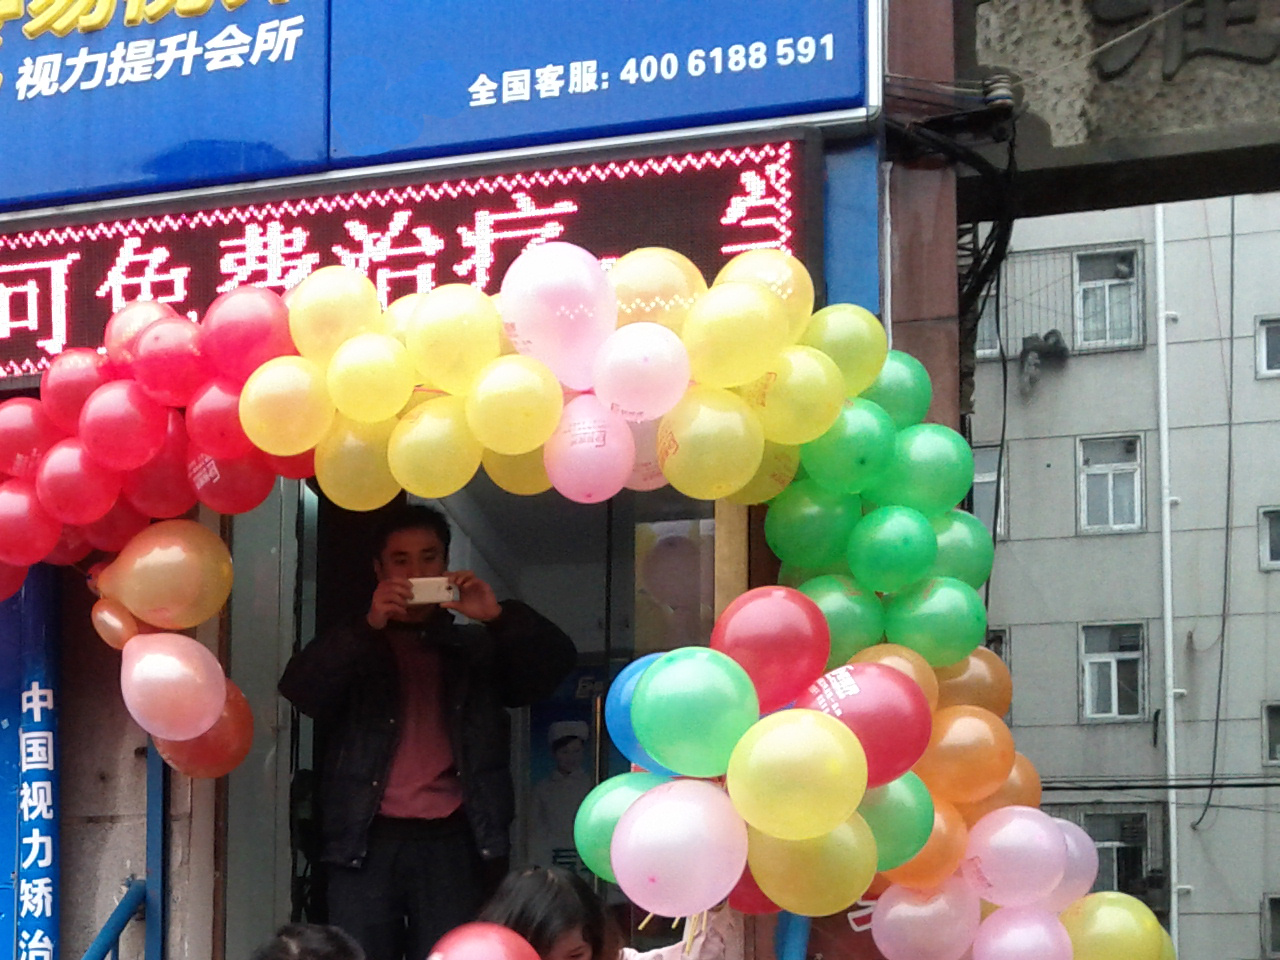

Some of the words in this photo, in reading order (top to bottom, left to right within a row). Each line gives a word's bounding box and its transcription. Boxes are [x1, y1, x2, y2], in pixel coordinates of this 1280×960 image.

[15, 15, 304, 100] 视力提升会所
[620, 51, 679, 86] 400
[686, 41, 770, 80] 6188
[776, 32, 836, 66] 591
